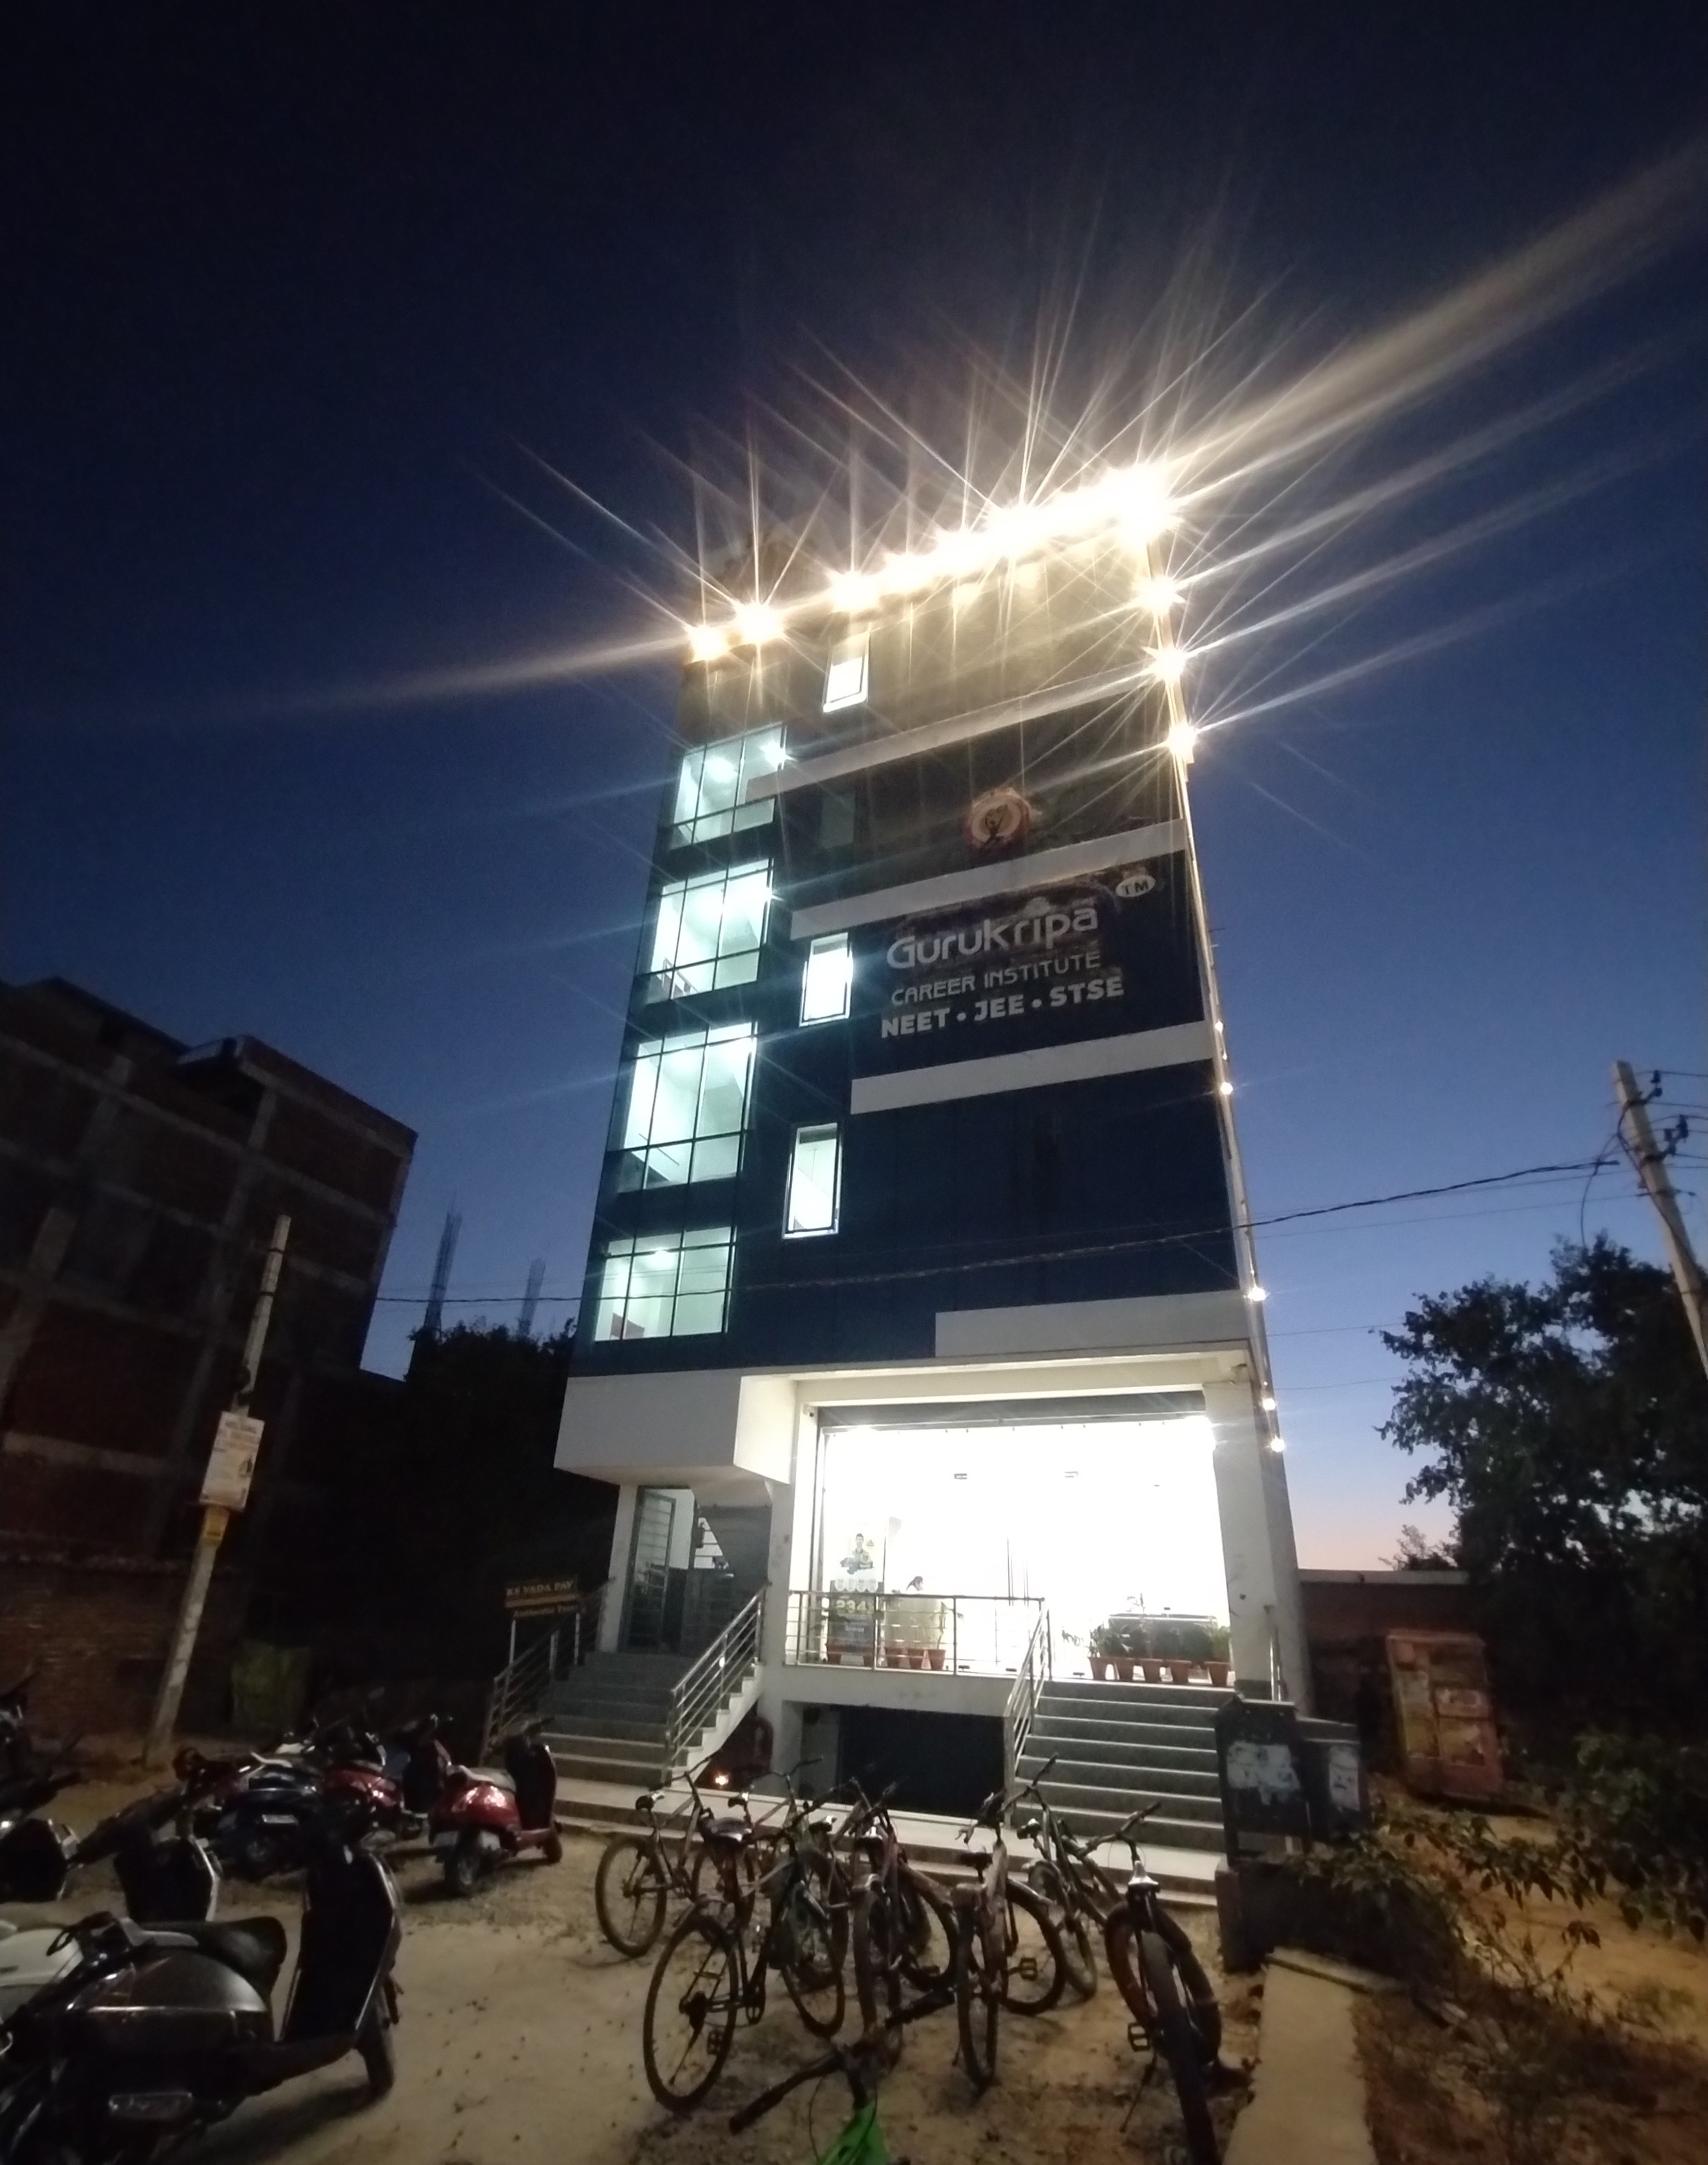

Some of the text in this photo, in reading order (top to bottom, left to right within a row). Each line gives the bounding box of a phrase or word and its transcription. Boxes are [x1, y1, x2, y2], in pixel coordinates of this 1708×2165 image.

[1121, 879, 1150, 895] TM
[887, 907, 1099, 970] Gurukripa
[881, 976, 1125, 1040] NEET JEE STSE
[891, 950, 1102, 1007] CAREER INSTITUTE
